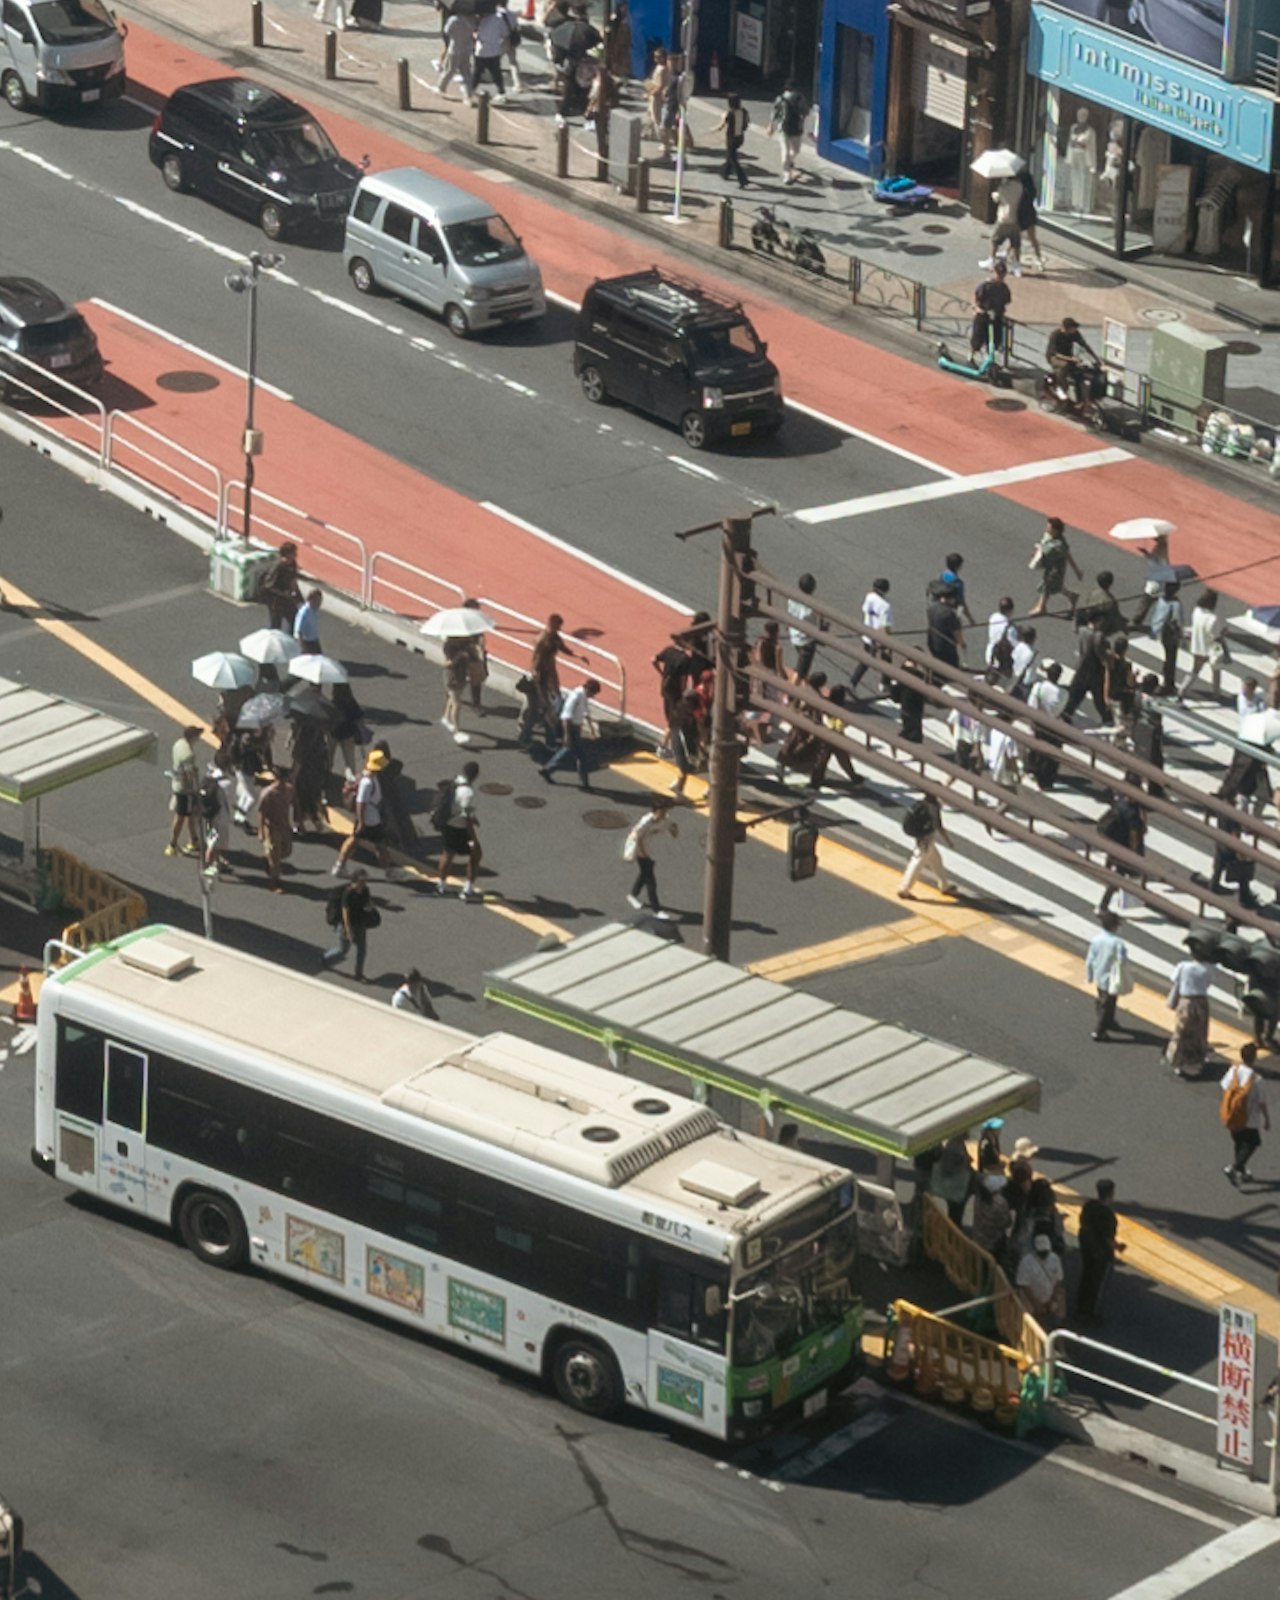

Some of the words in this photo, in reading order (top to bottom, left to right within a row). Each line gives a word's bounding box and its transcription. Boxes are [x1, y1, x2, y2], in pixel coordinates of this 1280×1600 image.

[1073, 40, 1225, 118] intimissimi
[1220, 1327, 1253, 1464] 横断禁止
